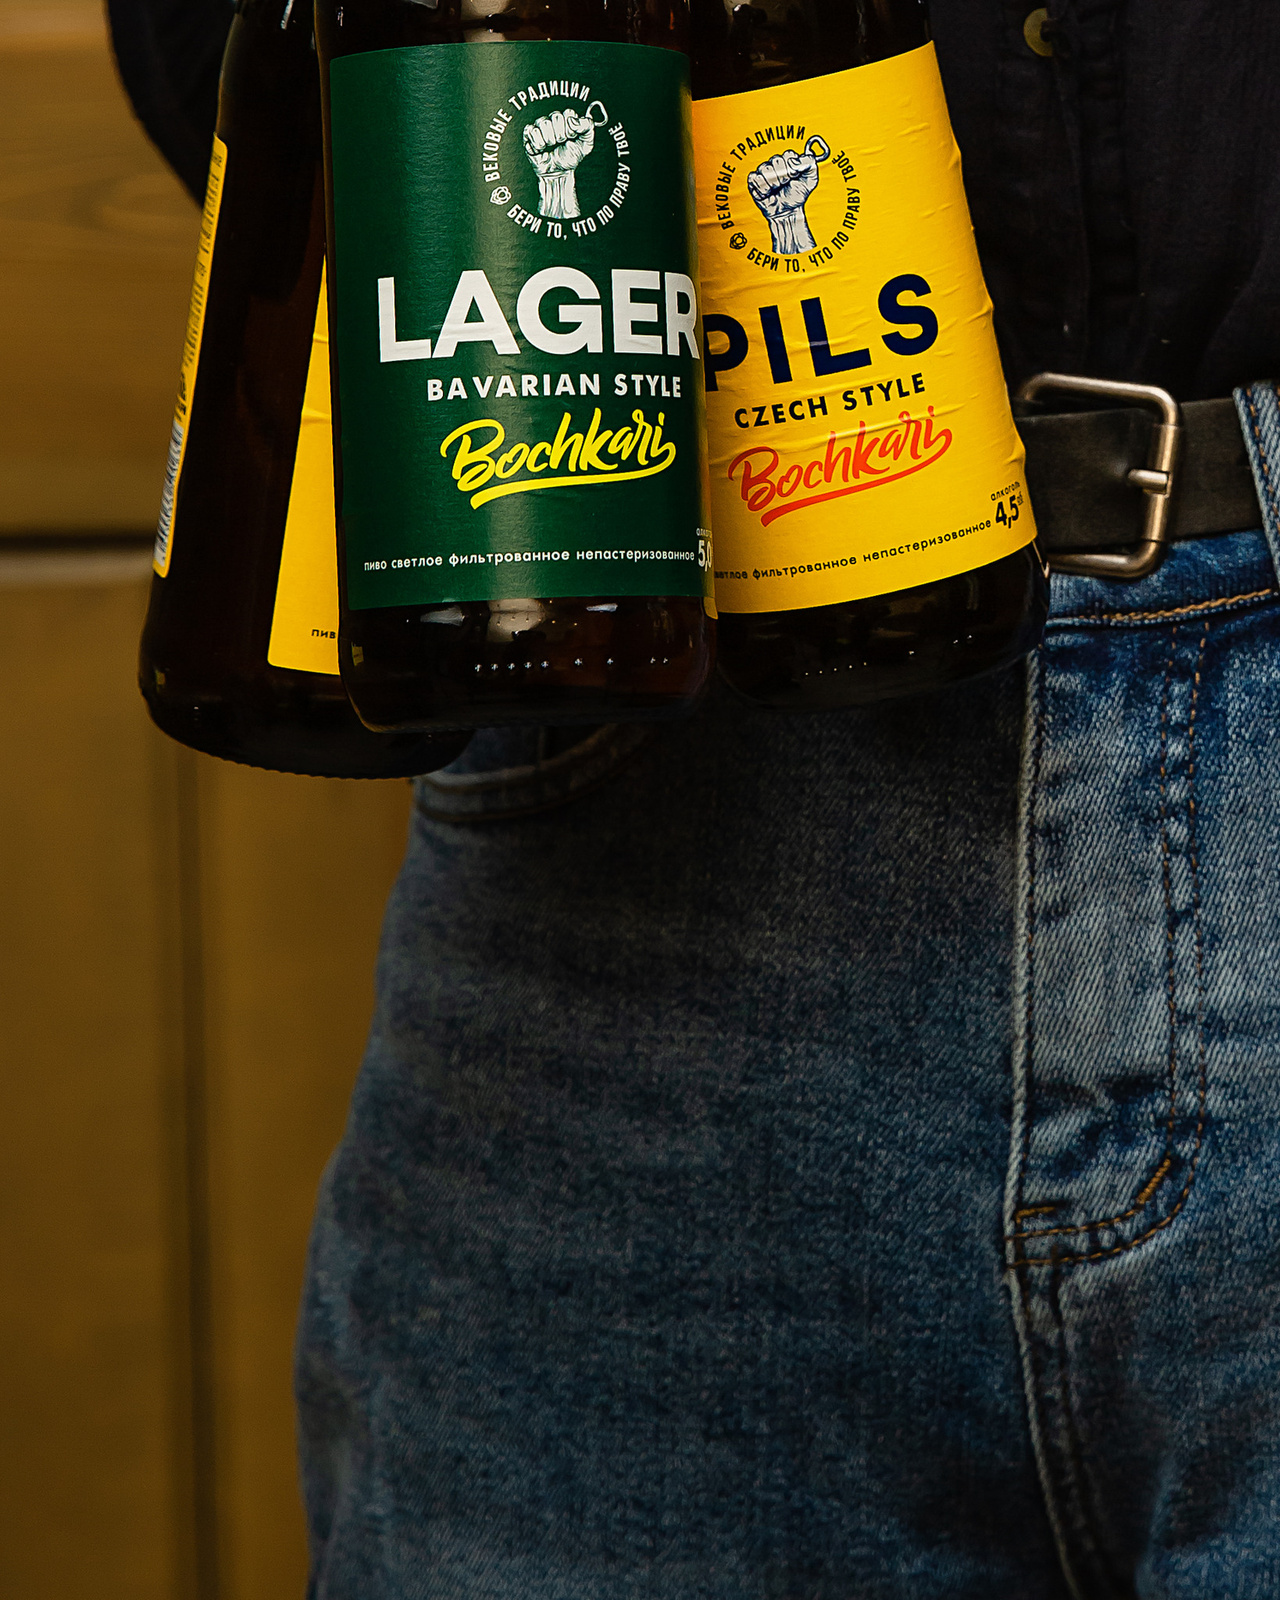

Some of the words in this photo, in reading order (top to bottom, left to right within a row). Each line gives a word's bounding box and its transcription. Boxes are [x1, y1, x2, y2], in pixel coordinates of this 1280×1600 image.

[482, 108, 513, 183] ВЕКОВЫЕ
[508, 80, 590, 111] ТРАДИЦИИ
[608, 122, 630, 158] ТВОЁ
[715, 162, 736, 230] ВЕКОВЫЕ
[730, 125, 806, 161] ТРАДИЦИИ
[831, 150, 857, 183] ТВОЁ
[609, 162, 631, 208] ПРАВУ
[506, 203, 543, 234] БЕРИ
[595, 204, 615, 226] ПО
[842, 187, 860, 230] ПРАВУ
[546, 221, 567, 241] ТО,
[571, 219, 597, 237] ЧТО
[831, 231, 849, 250] ПО
[746, 248, 780, 271] БЕРИ
[784, 258, 806, 273] ТО,
[808, 246, 833, 267] ЧТО
[377, 266, 700, 363] LAGER
[702, 273, 939, 392] PILS
[427, 373, 600, 401] BAVARIAN
[613, 374, 682, 398] STYLE
[734, 395, 829, 429] CZECH
[842, 372, 926, 412] STYLE
[440, 407, 676, 510] Bochkari
[727, 405, 953, 528] Bochkari
[995, 494, 1020, 529] 4,5
[363, 560, 387, 572] пиво
[391, 555, 443, 569] светлое
[448, 548, 570, 569] фильтрованное
[576, 548, 695, 564] непастеризованное
[714, 570, 748, 579] ветлое
[752, 555, 858, 581] фильтрованное
[862, 518, 992, 564] непастеризованное
[311, 628, 337, 639] пив
